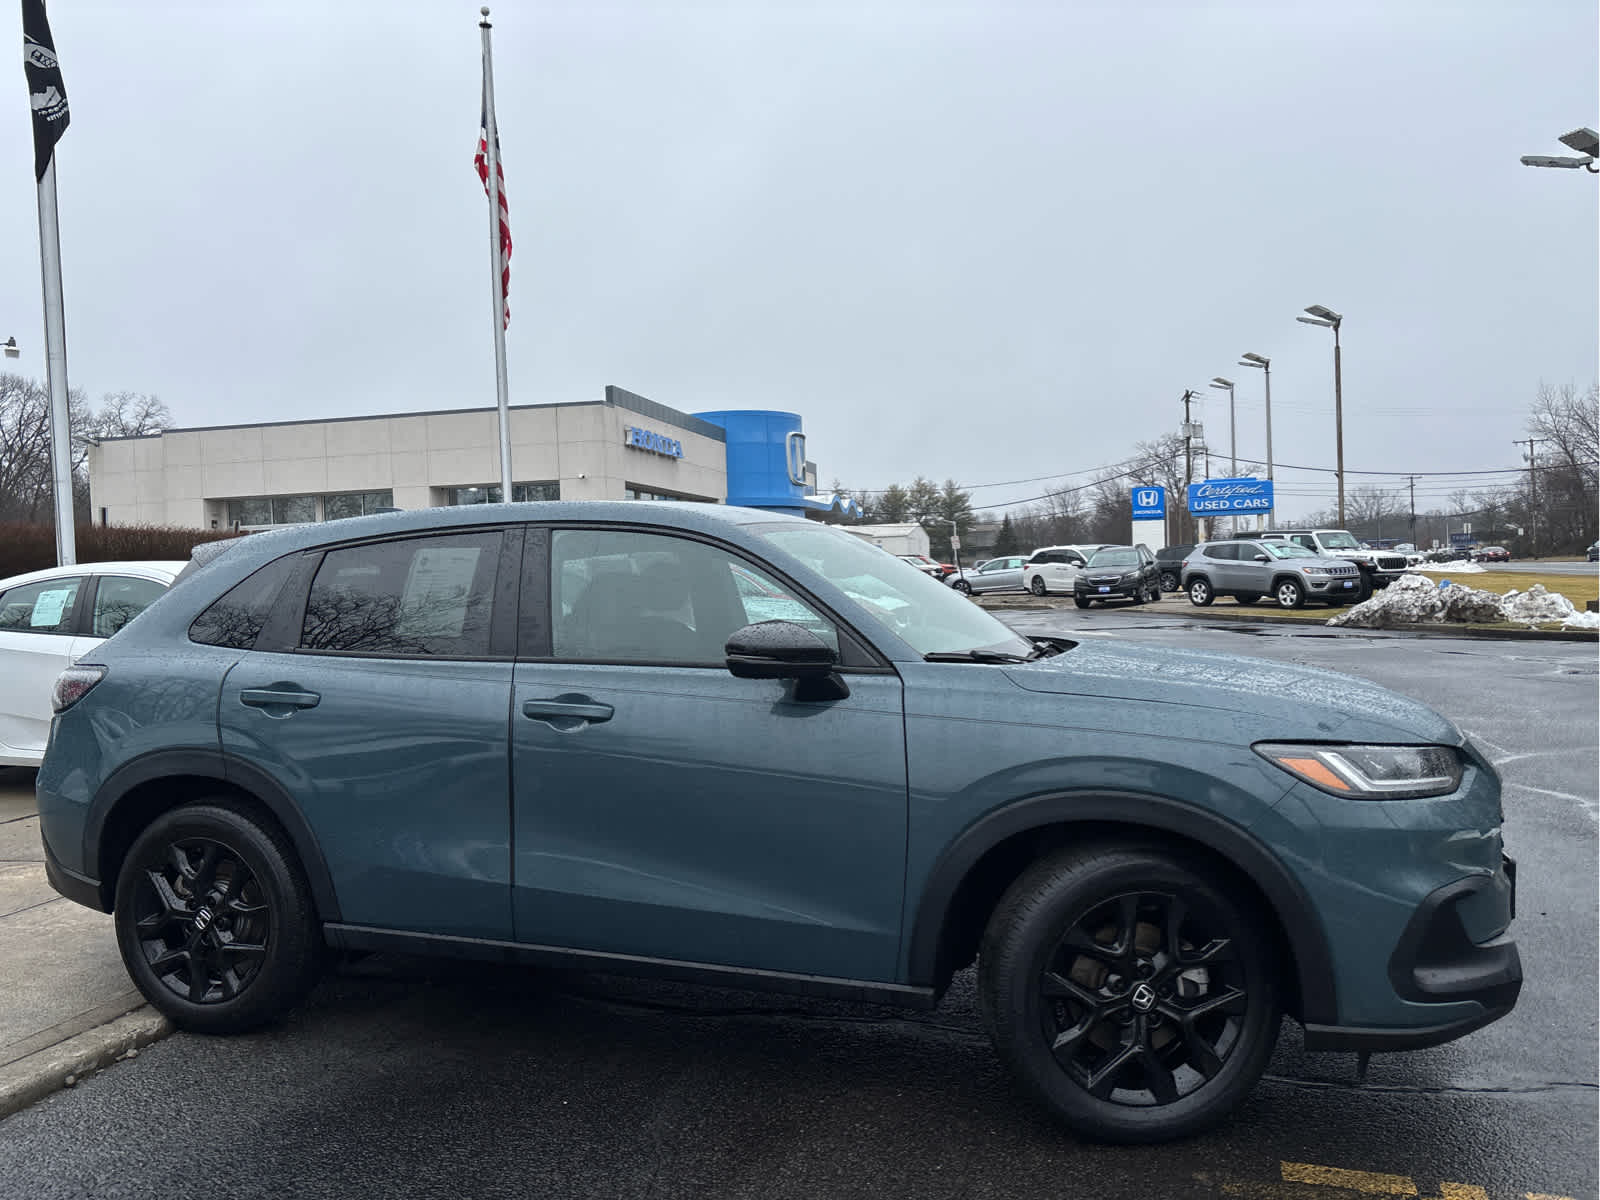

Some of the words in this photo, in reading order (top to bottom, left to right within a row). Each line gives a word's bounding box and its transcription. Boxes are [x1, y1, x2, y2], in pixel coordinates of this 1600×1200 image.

[626, 426, 684, 459] HONDA
[1197, 484, 1264, 499] Certified
[1194, 500, 1230, 510] USED
[1233, 498, 1269, 509] CARS
